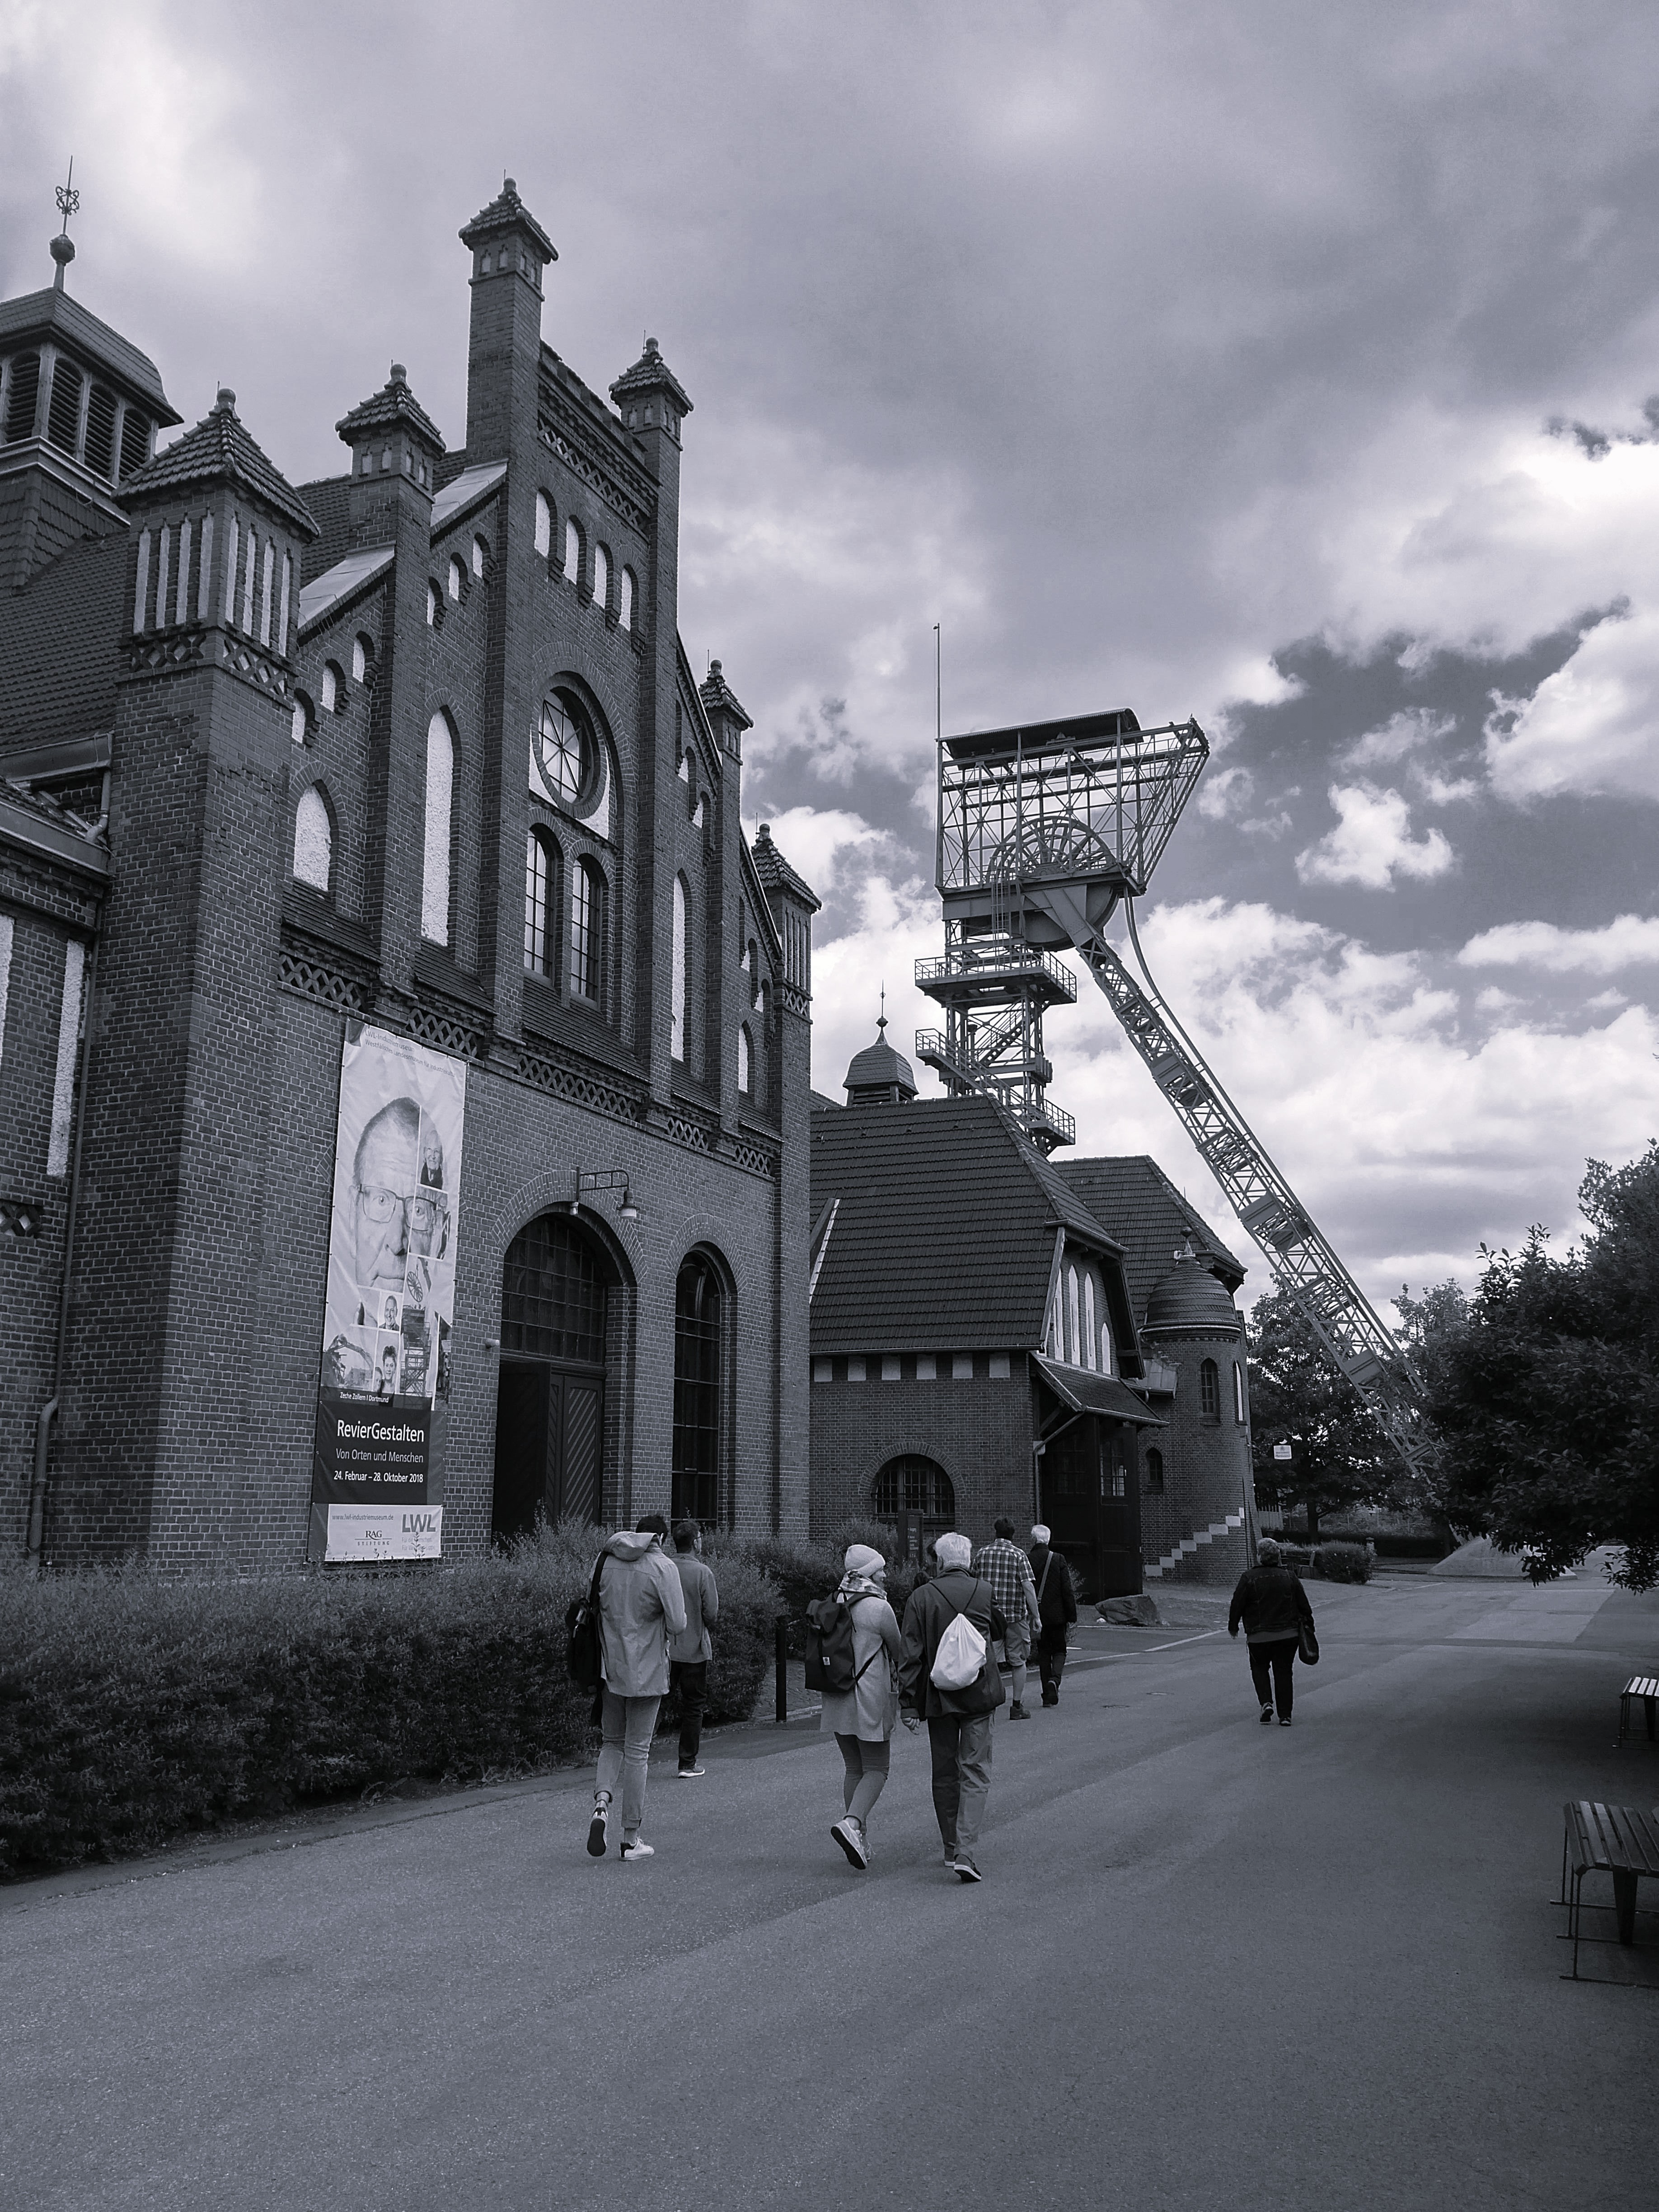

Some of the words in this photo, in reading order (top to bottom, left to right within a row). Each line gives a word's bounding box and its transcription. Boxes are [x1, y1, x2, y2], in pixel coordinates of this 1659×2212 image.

[337, 1420, 424, 1442] RevierGestalten
[336, 1448, 349, 1459] Von
[351, 1449, 371, 1460] Orten
[374, 1450, 387, 1461] und
[389, 1451, 423, 1463] Menschen
[333, 1471, 343, 1480] 24.
[345, 1471, 367, 1481] Februar
[373, 1472, 382, 1481] 28.
[384, 1472, 408, 1482] Oktober
[409, 1473, 423, 1483] 2018
[402, 1514, 436, 1532] LWL
[365, 1530, 382, 1541] RAG
